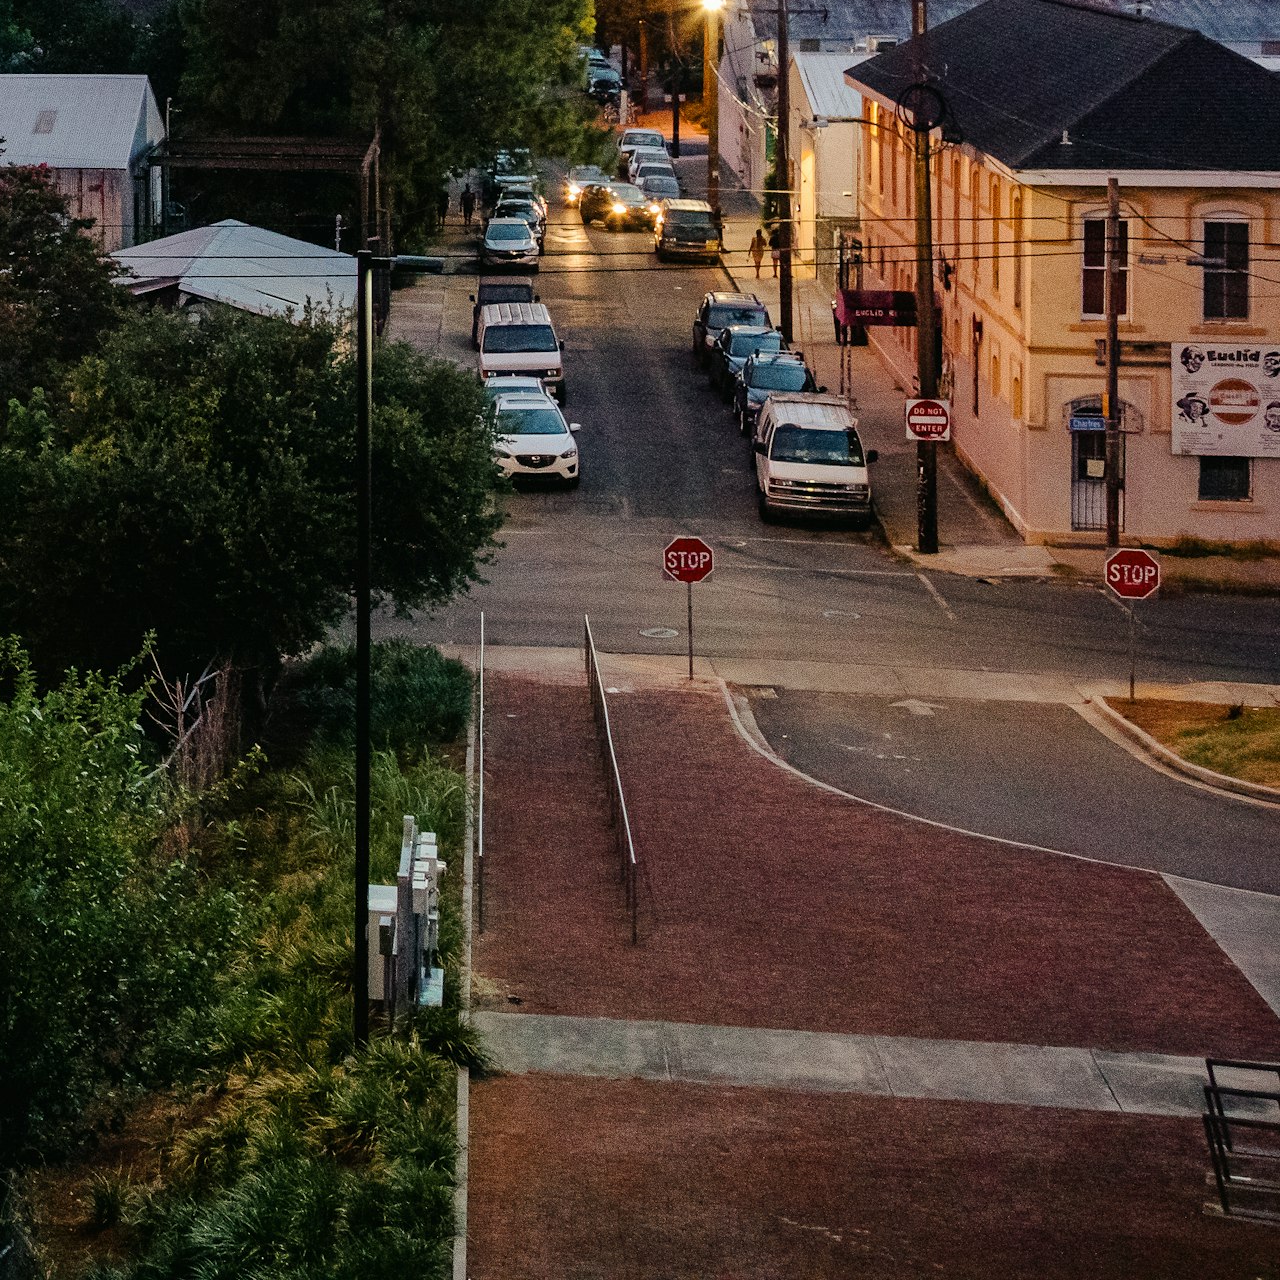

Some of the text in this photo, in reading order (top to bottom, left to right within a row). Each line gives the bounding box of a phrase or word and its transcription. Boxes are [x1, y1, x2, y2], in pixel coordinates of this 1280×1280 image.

[1206, 349, 1260, 362] Euclid
[913, 407, 925, 415] DO
[915, 424, 943, 433] ENTER
[1072, 419, 1101, 428] Chartres
[667, 551, 711, 569] STOP
[1109, 563, 1157, 584] STOP
